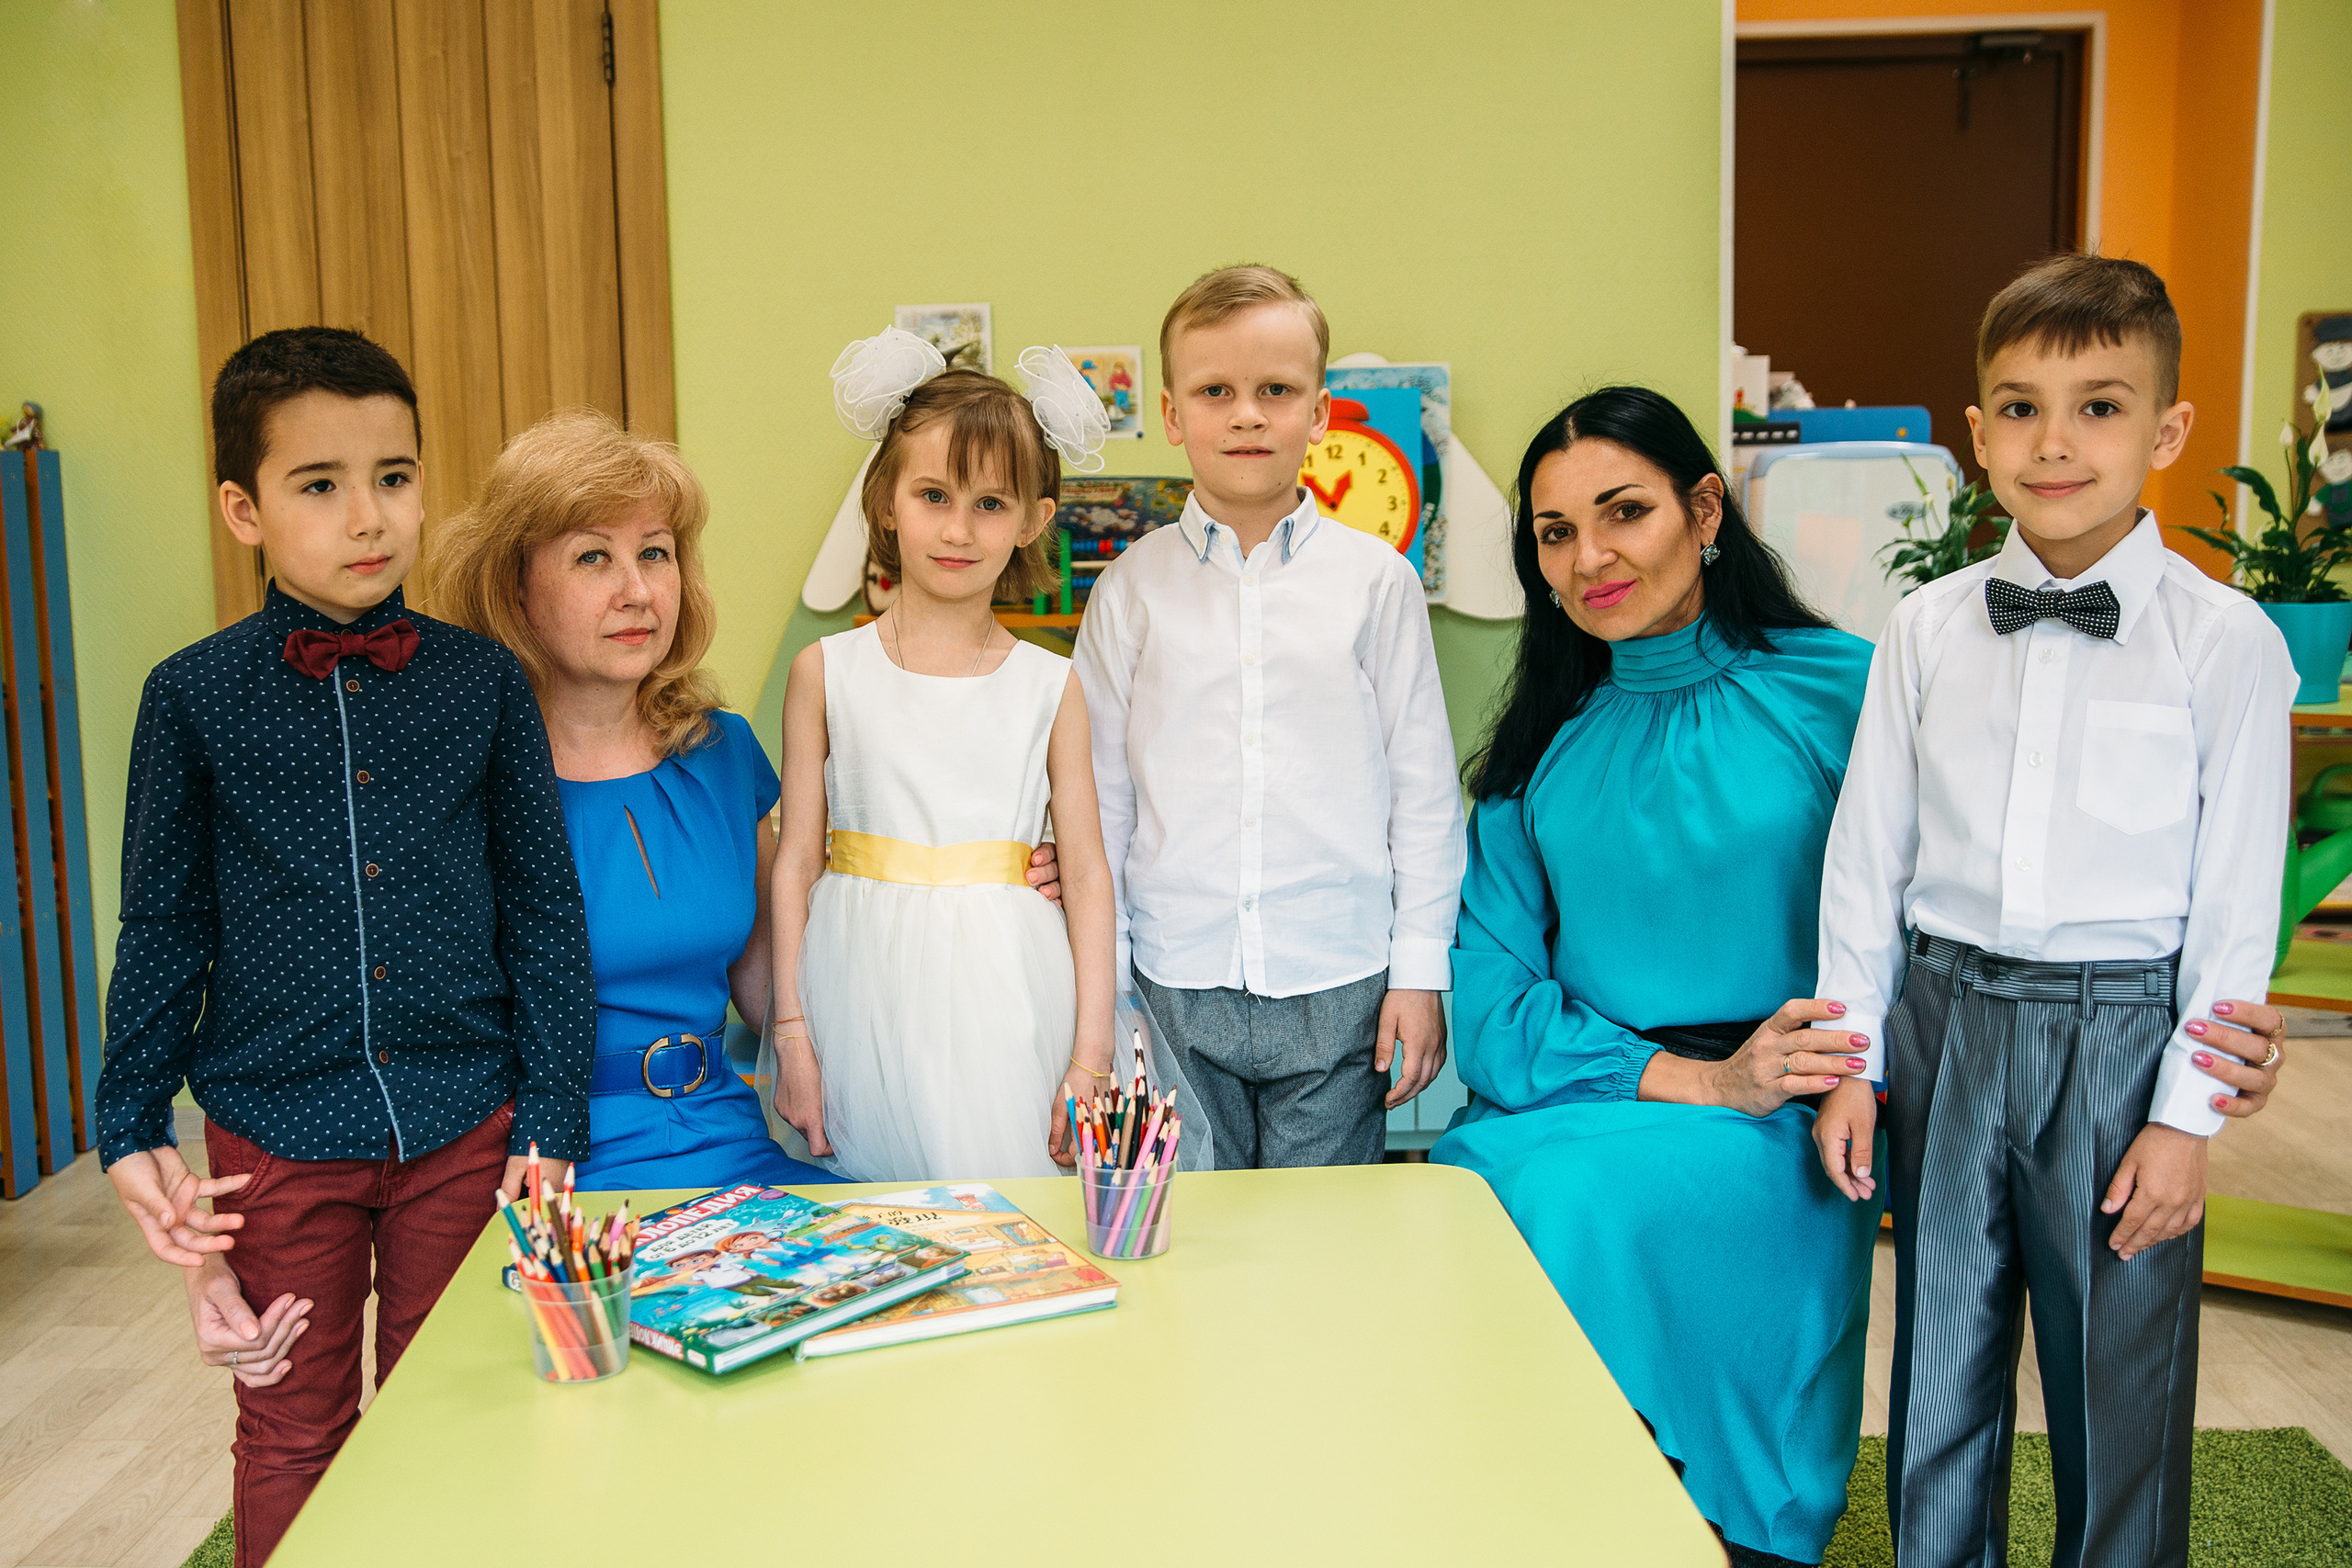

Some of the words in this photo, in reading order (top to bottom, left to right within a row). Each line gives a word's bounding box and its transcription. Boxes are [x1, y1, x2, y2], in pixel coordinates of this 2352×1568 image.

[1326, 444, 1342, 459] 12
[1358, 451, 1365, 466] 1
[1378, 468, 1387, 483] 2
[1387, 495, 1397, 511] 3
[1379, 521, 1390, 536] 4
[650, 1240, 675, 1252] ДЛЯ
[676, 1223, 713, 1240] ДЕТЕЙ
